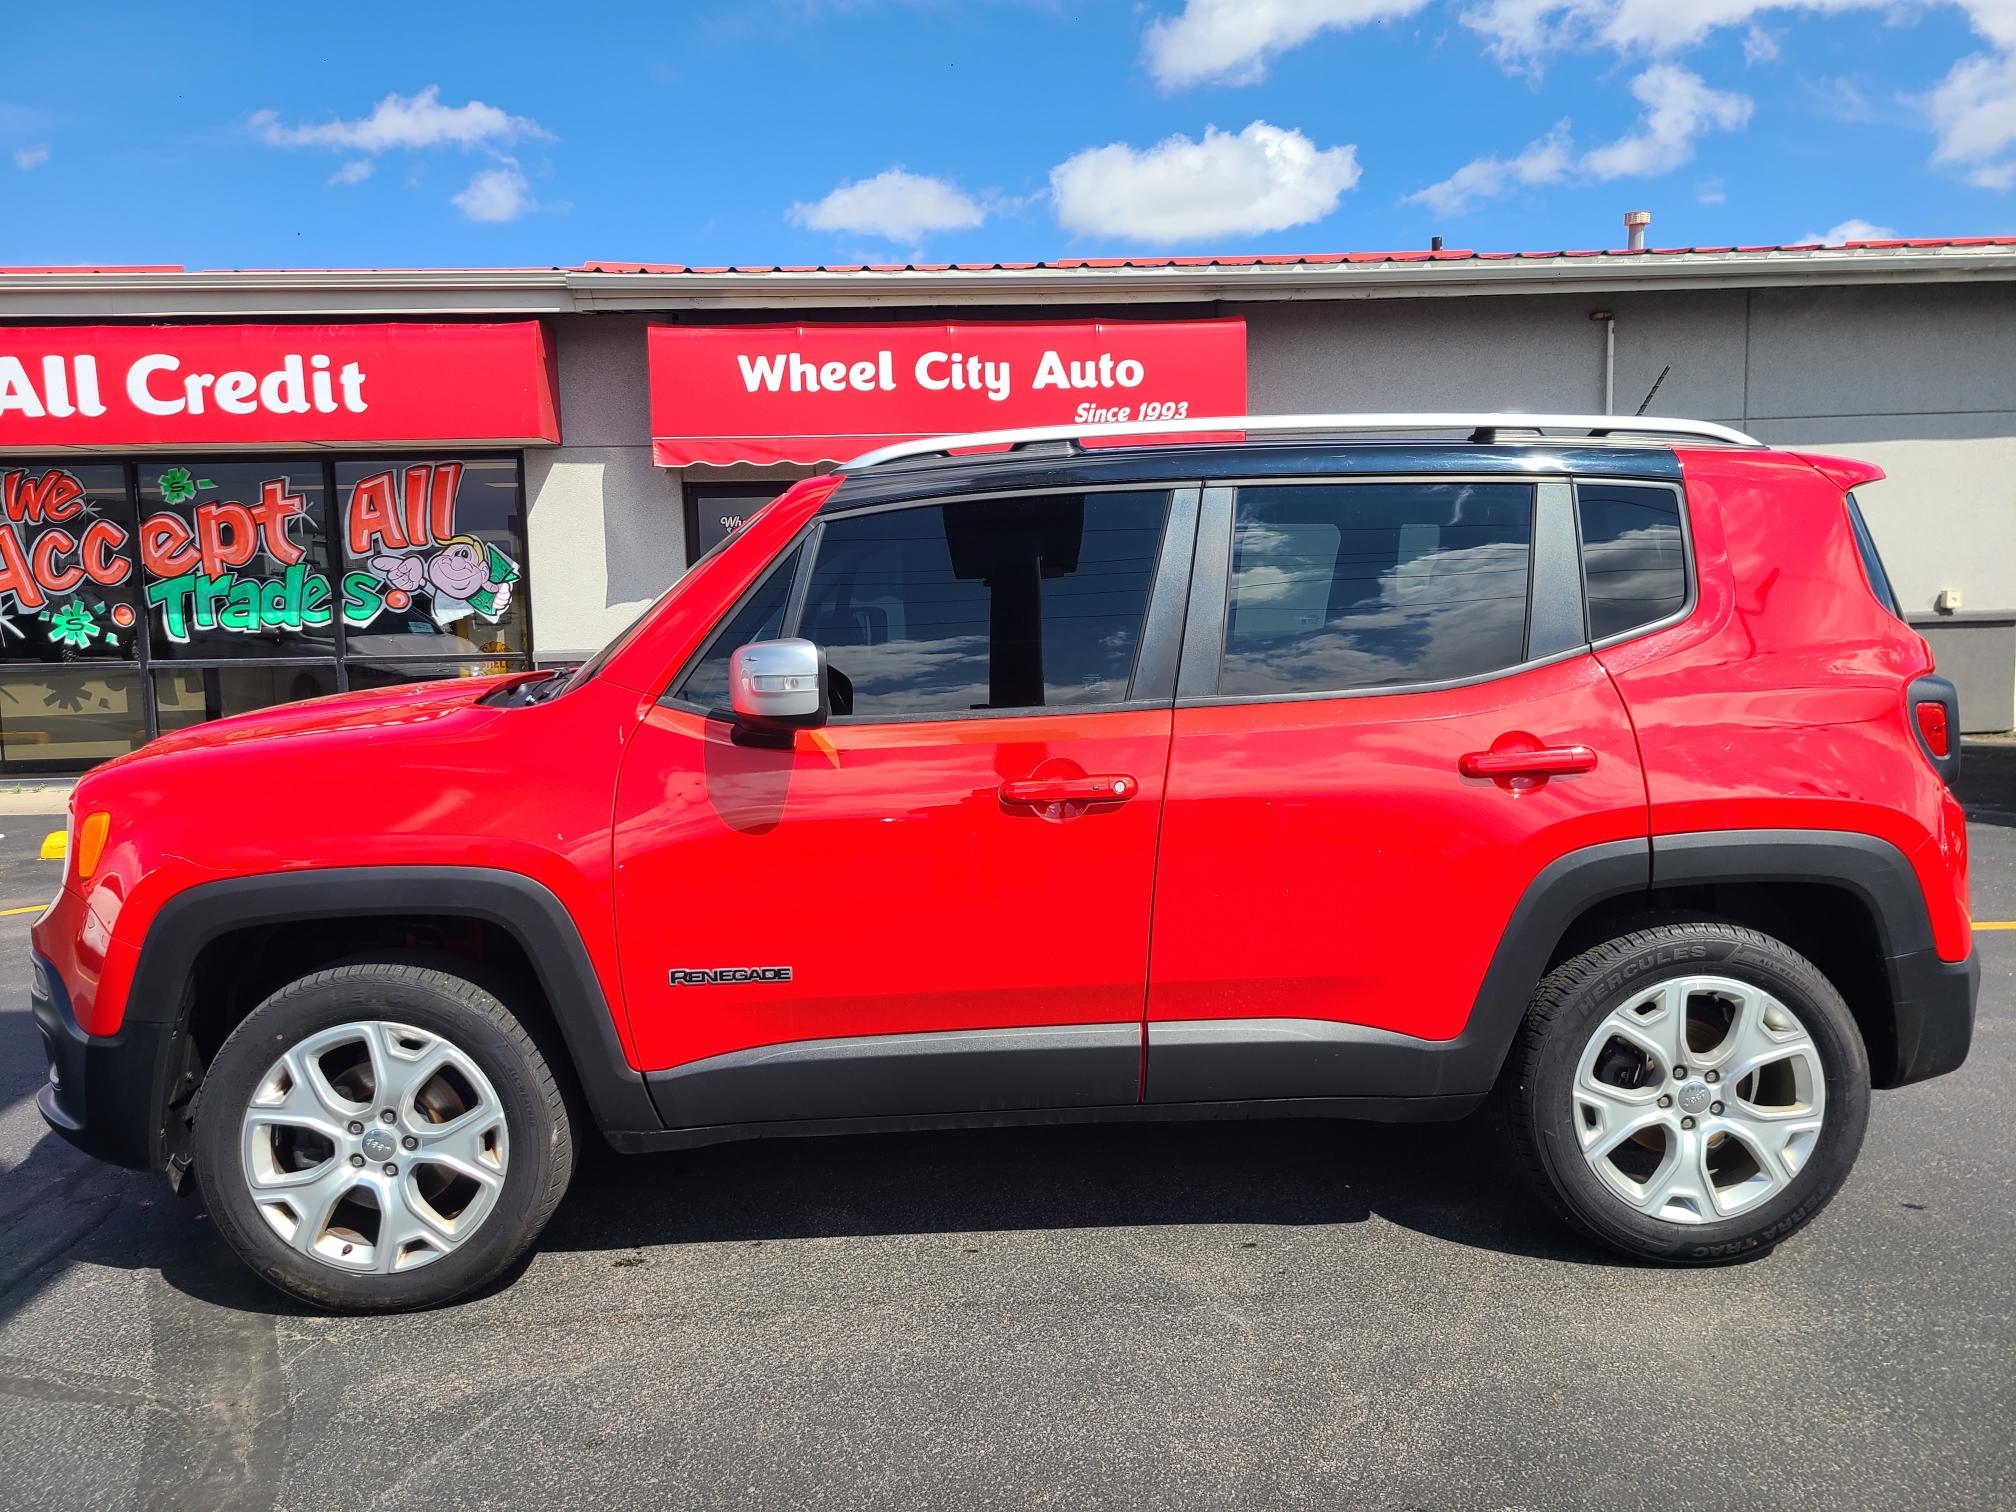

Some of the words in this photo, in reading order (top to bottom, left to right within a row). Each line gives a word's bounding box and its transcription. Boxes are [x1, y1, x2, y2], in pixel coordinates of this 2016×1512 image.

[0, 353, 106, 418] All
[126, 354, 369, 416] Credit
[737, 350, 897, 392] Wheel
[914, 352, 1011, 400] City
[1032, 351, 1145, 389] Auto
[1074, 402, 1130, 423] Since
[1137, 401, 1189, 421] 1993
[3, 469, 86, 524] We
[348, 462, 465, 556] All
[147, 563, 384, 645] Trades
[669, 966, 793, 986] RENEGADE
[1577, 944, 1708, 1018] HERCULES
